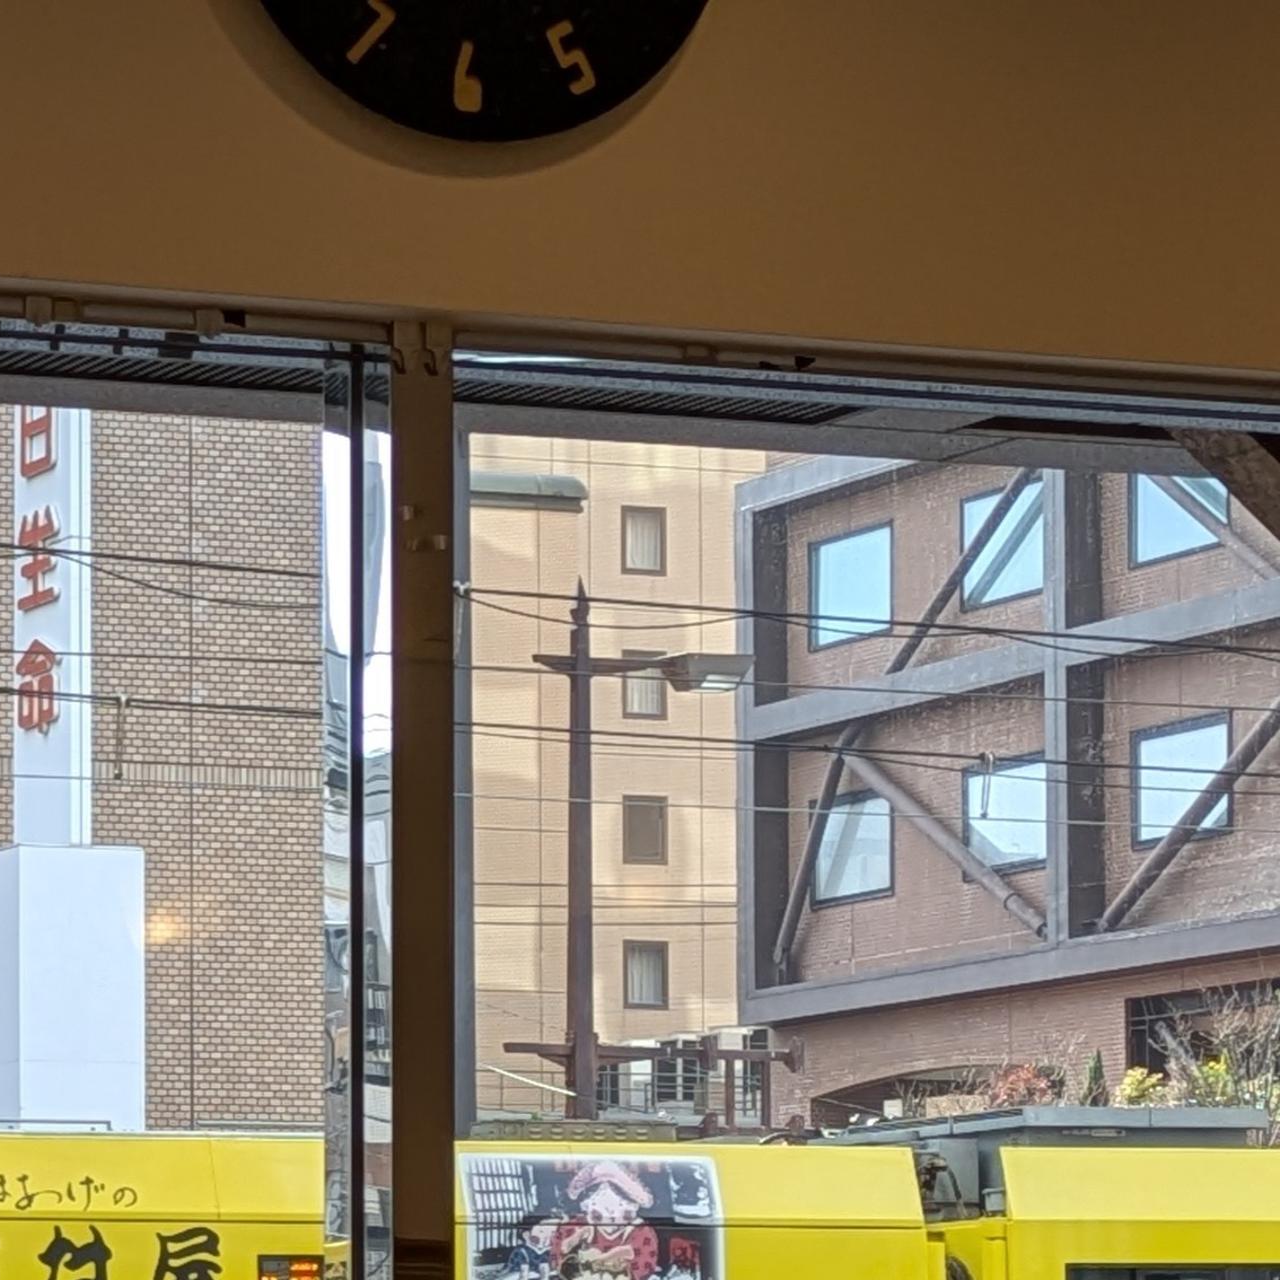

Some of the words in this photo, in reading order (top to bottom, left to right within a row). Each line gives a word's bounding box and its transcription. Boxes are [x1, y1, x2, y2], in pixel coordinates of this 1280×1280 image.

[345, 0, 397, 65] 7
[545, 18, 597, 97] 5
[452, 39, 483, 114] 6
